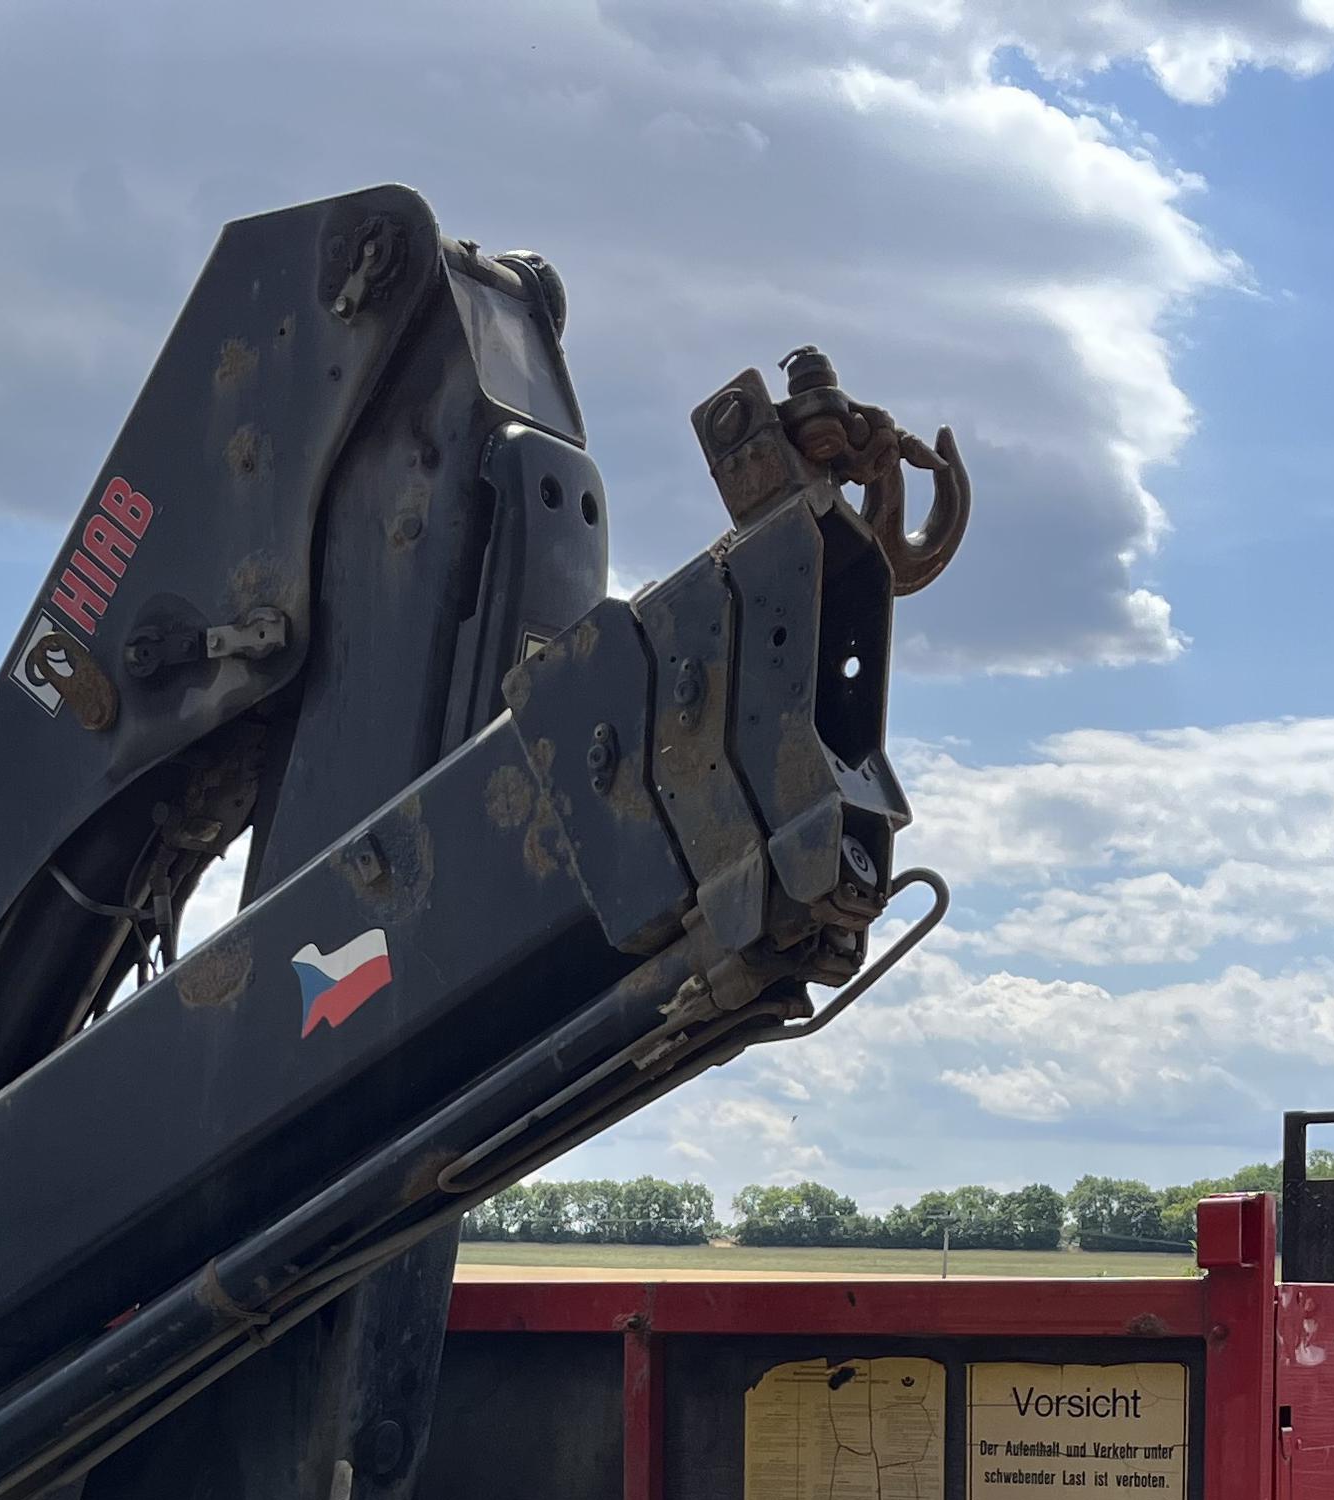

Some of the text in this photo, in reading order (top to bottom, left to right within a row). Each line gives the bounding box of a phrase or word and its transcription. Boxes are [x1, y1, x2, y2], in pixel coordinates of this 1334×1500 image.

[51, 476, 154, 636] HIAB
[1012, 1387, 1141, 1418] Vorsicht
[980, 1440, 1173, 1459] Der Aufenthalt und Verkehr unter
[984, 1468, 1170, 1488] schwebender Last ist verboten.
